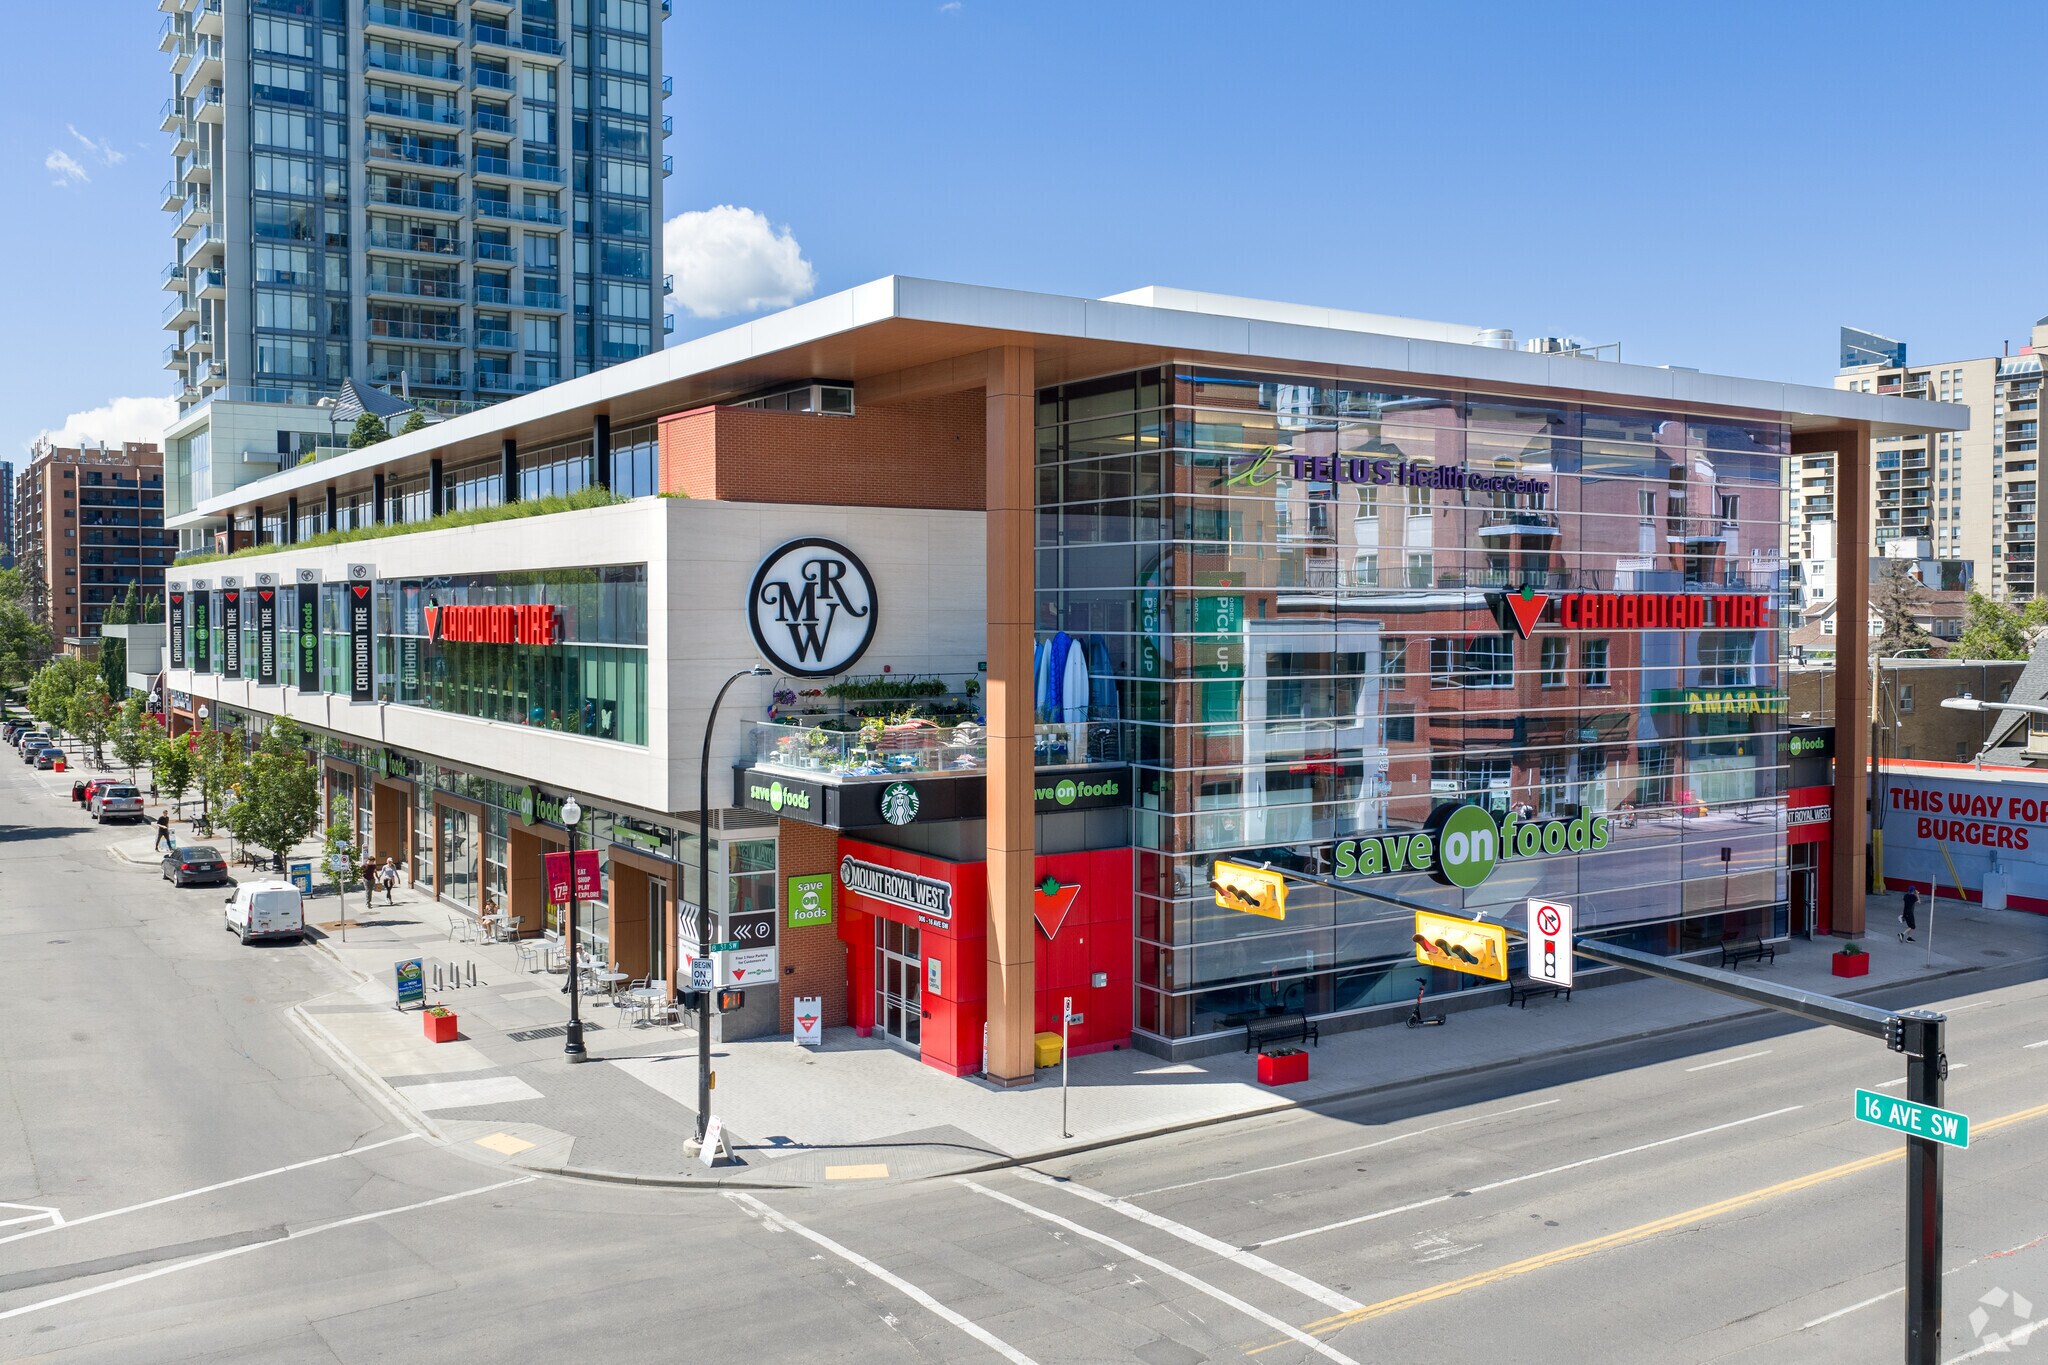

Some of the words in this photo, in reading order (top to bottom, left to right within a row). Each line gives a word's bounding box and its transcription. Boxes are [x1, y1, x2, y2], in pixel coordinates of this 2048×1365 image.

[1290, 455, 1391, 485] TELUS
[1399, 462, 1466, 489] Health
[1468, 472, 1504, 492] Care
[1503, 474, 1550, 495] Centre
[173, 608, 181, 625] TIRE
[227, 608, 237, 627] TIRE
[261, 608, 272, 628] TIRE
[302, 602, 313, 633] foods
[355, 607, 367, 632] TIRE
[1144, 597, 1153, 640] PICK
[1217, 597, 1229, 640] PICK
[1561, 593, 1704, 629] CANADIAN
[1711, 595, 1769, 628] TIRE
[442, 604, 515, 643] CANADIAN
[515, 604, 556, 646] TIRE
[174, 626, 182, 662] CANADIAN
[227, 628, 237, 671] CANADIAN
[262, 630, 273, 676] CANADIAN
[305, 635, 313, 647] on
[305, 649, 313, 673] save
[356, 634, 368, 691] CANADIAN
[1144, 647, 1153, 672] UP
[1217, 647, 1229, 673] UP
[1790, 742, 1801, 750] on
[1802, 737, 1825, 750] foods
[504, 791, 521, 809] save
[521, 797, 532, 814] on
[750, 785, 770, 801] save
[782, 786, 809, 809] foods
[1034, 787, 1054, 800] ve
[1057, 788, 1074, 798] on
[1077, 780, 1119, 797] foods
[1794, 810, 1814, 822] ROYAL
[1814, 807, 1832, 820] WEST
[1889, 787, 1944, 813] THIS
[1948, 792, 2003, 819] WAY
[1335, 833, 1433, 878] save
[1445, 828, 1493, 865] on
[1500, 805, 1609, 860] foods
[1917, 816, 2030, 851] BURGERS
[577, 868, 586, 876] EAT
[798, 881, 823, 892] save
[851, 865, 884, 892] MOUNT
[884, 874, 915, 902] ROYAL
[915, 882, 945, 910] WEST
[802, 895, 818, 906] on
[794, 907, 827, 920] foods
[933, 919, 942, 928] AVE
[694, 961, 711, 969] BEGIN
[693, 979, 711, 987] WAY
[1864, 1096, 1882, 1120] 16
[1888, 1103, 1922, 1131] AVE
[1930, 1113, 1959, 1140] SW
